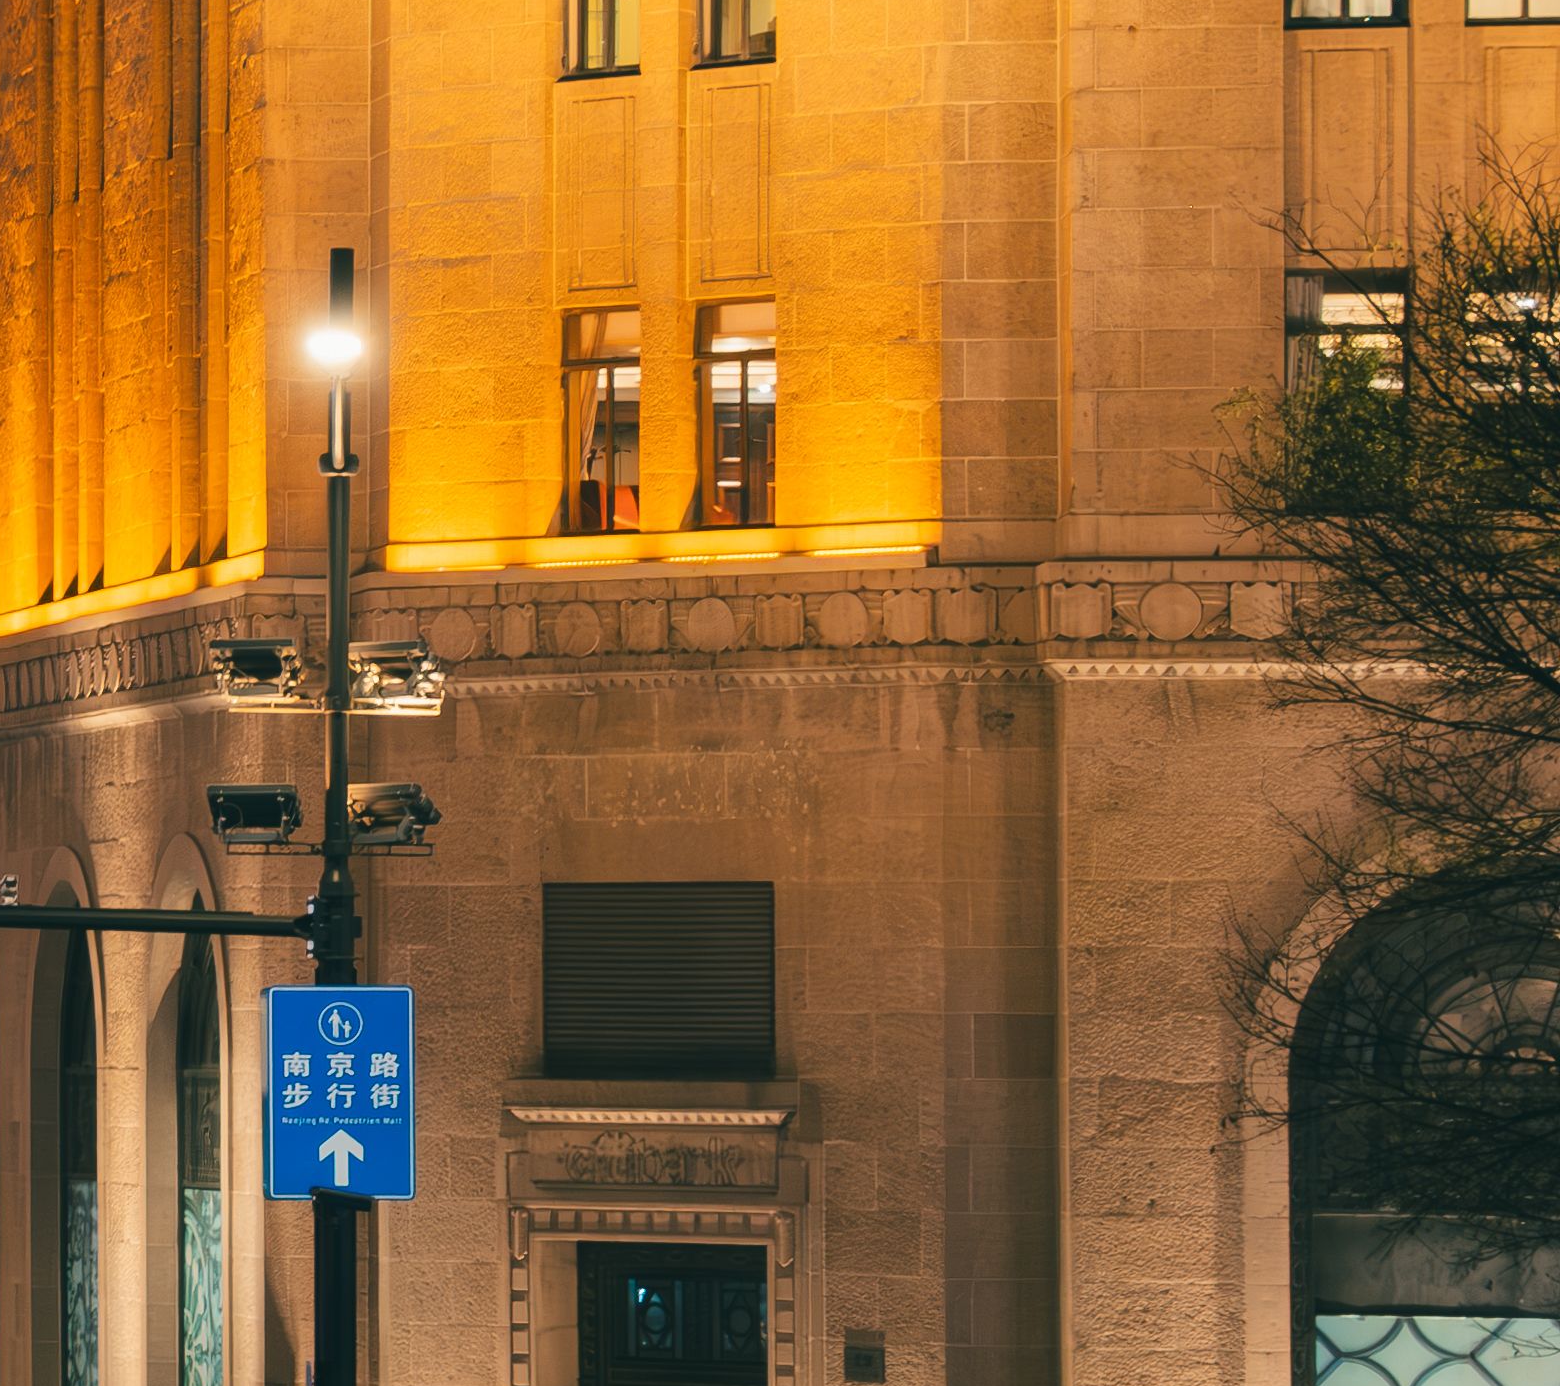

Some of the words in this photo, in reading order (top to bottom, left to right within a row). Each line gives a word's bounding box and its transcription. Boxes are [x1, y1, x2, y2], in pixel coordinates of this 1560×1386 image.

[282, 1051, 400, 1078] 南京路
[282, 1082, 401, 1109] 步行街
